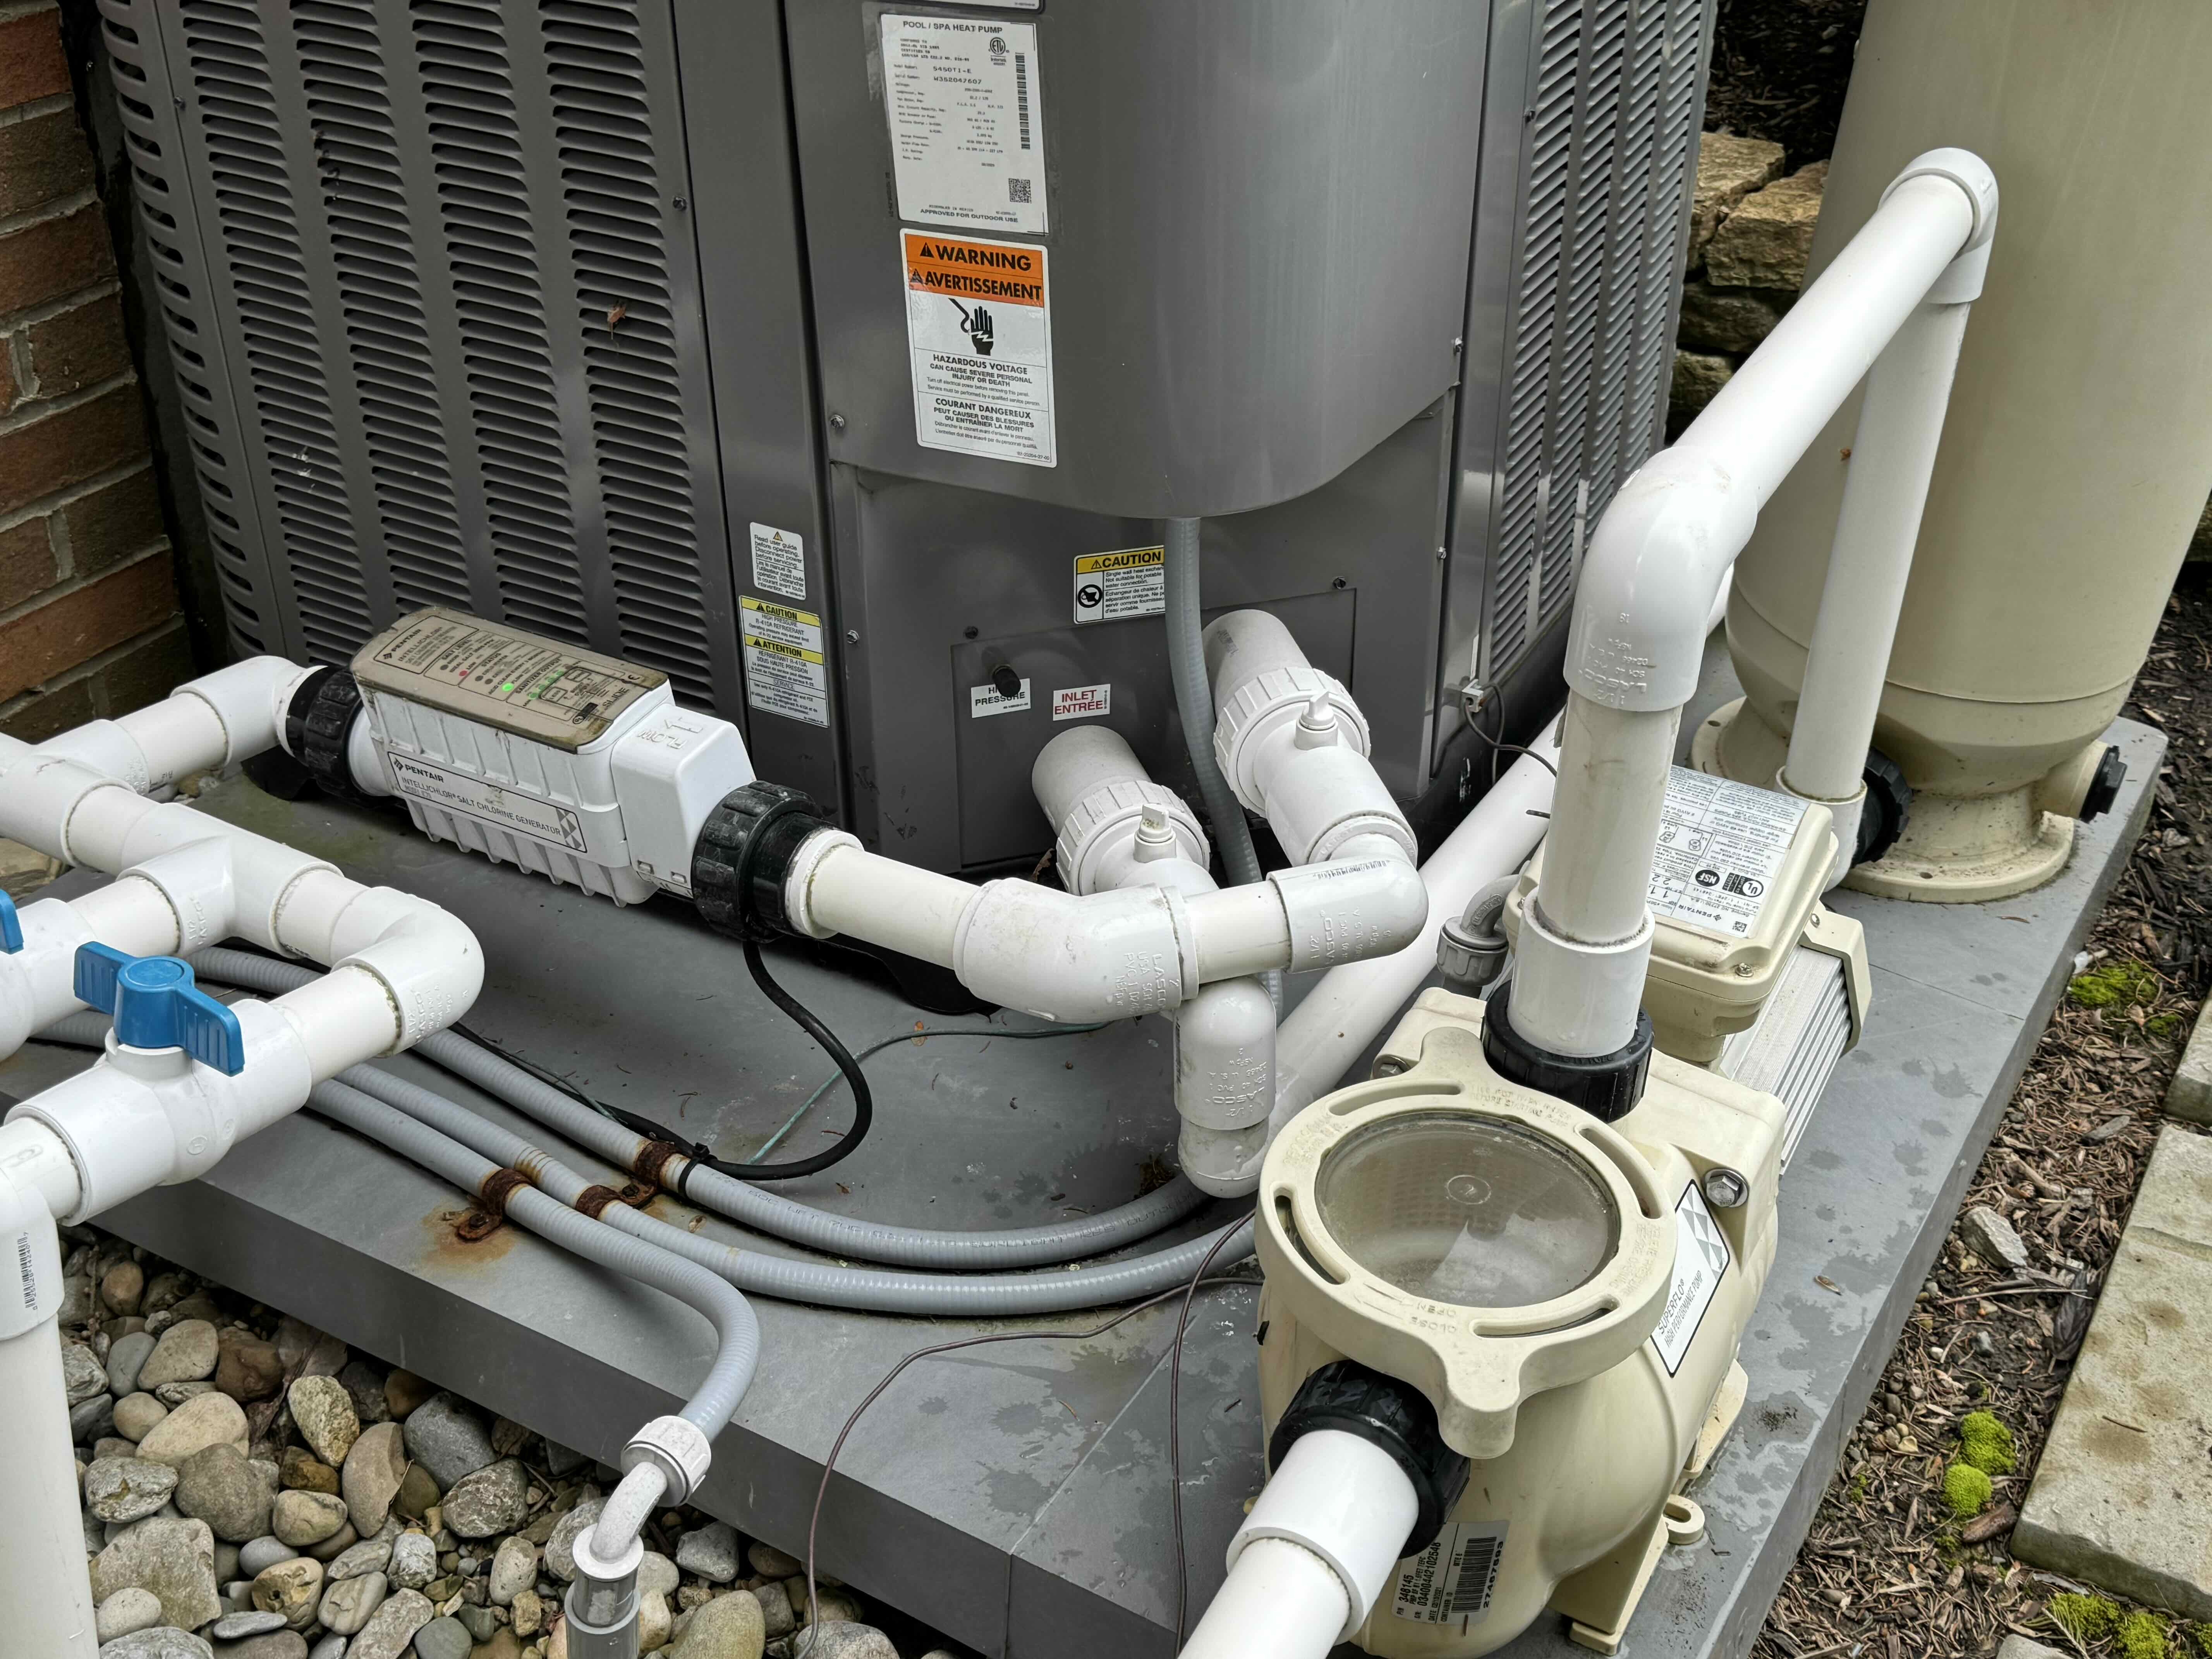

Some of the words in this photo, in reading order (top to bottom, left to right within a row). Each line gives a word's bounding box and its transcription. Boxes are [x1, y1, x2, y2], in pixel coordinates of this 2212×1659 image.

[936, 245, 1030, 271] WARNING
[925, 271, 1042, 301] AVERTISSEMENT
[933, 354, 987, 369] HAZARDOUS
[989, 362, 1027, 374] VOLTAGE
[952, 373, 975, 382] INJURY
[988, 379, 1010, 387] DEATH
[969, 369, 994, 378] SEVERE
[997, 374, 1032, 384] PERSONAL
[936, 398, 976, 410] COURANT
[979, 405, 1031, 419] DANGEREUX
[953, 410, 979, 419] CAUSER
[996, 417, 1034, 428] BLESSURES
[755, 534, 768, 543] Read
[755, 541, 771, 549] before
[756, 546, 784, 558] Disconnect
[756, 553, 772, 561] before
[1103, 551, 1161, 568] CAUTION
[766, 605, 797, 620] CAUTION
[756, 618, 773, 627] R-410A
[774, 623, 804, 635] REFRIGERANT
[775, 617, 798, 627] PRESSURE
[391, 629, 421, 652] PENTAIR
[763, 641, 802, 658] ATTENTION
[770, 659, 784, 668] HAUTE
[785, 664, 808, 674] PRESSION
[603, 687, 629, 707] SLIDE
[1061, 689, 1097, 703] INLET
[1054, 700, 1103, 714] ENTRÉE
[637, 731, 687, 749] FLOW
[405, 764, 444, 783] PENTAIR
[457, 795, 475, 807] SALT
[477, 801, 515, 821] CHLORINE
[516, 815, 562, 836] GENERATOR
[1698, 872, 1718, 884] NSF
[1748, 882, 1758, 895] UL
[1678, 904, 1712, 918] PENTAIR
[1664, 1329, 1674, 1349] HIGH
[1673, 1287, 1697, 1331] PERFORMANCE
[1693, 1270, 1703, 1291] PUMP
[1398, 1574, 1414, 1602] 348145
